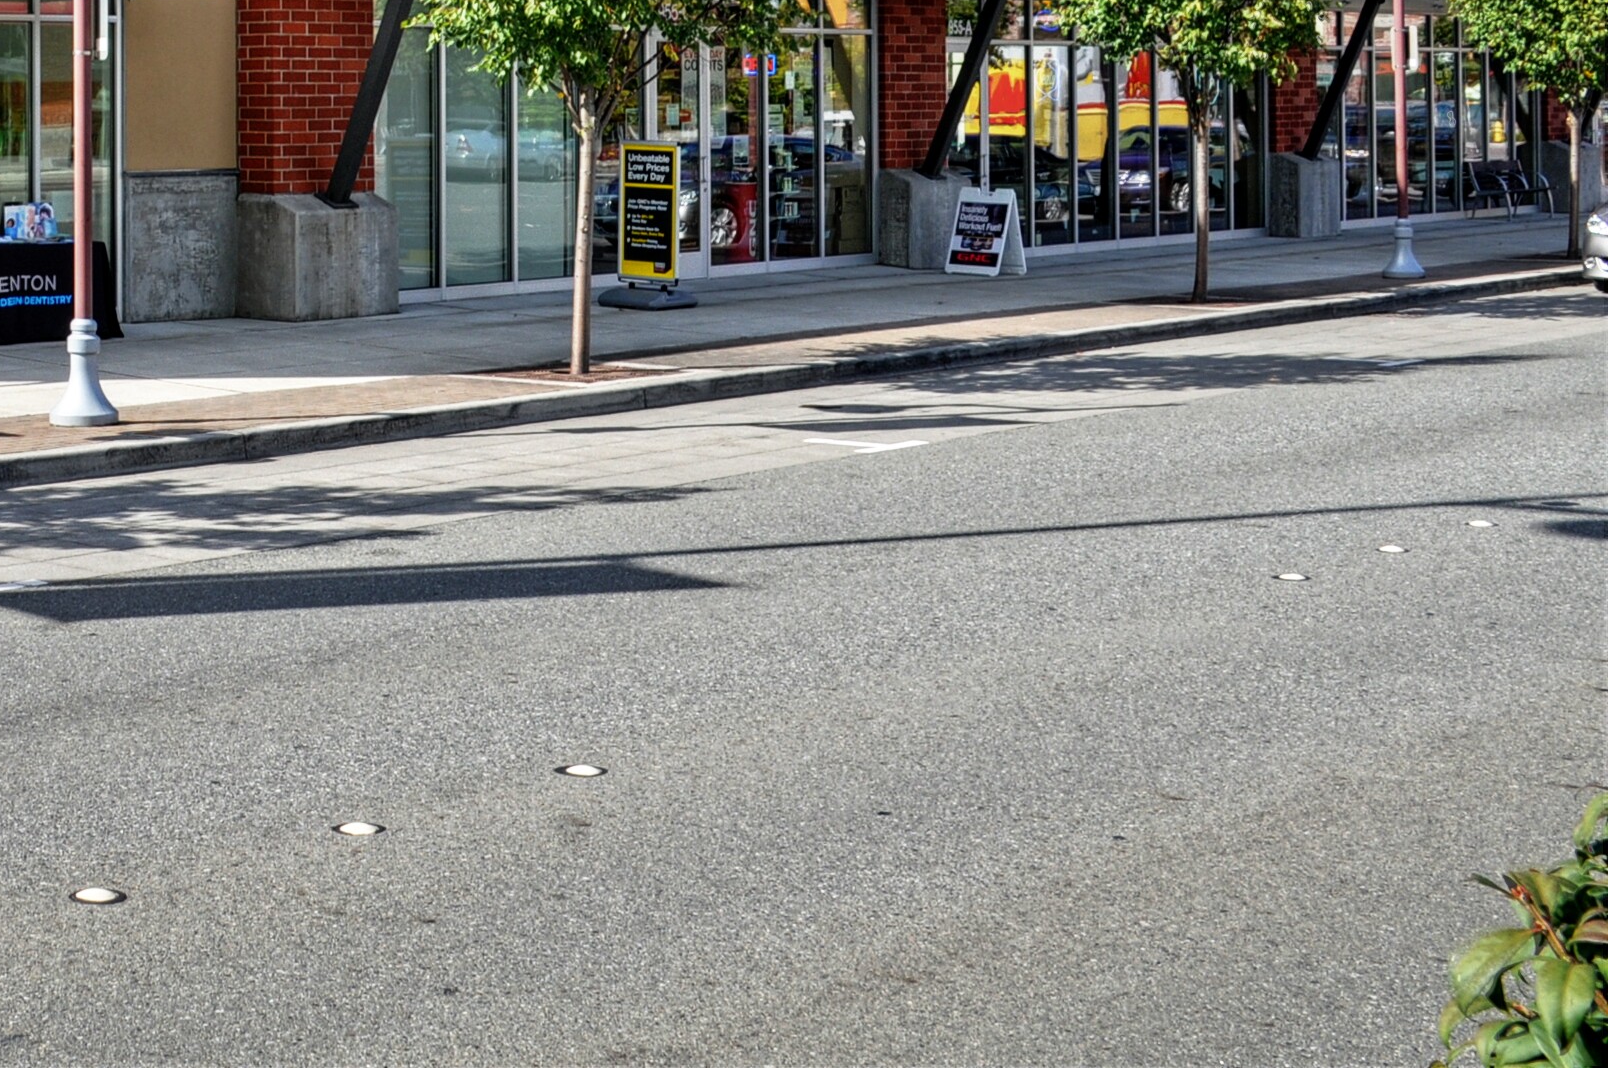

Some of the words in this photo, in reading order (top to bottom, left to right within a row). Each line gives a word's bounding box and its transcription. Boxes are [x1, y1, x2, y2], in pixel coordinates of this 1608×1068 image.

[684, 59, 724, 72] COTS
[742, 57, 773, 72] OPN
[628, 153, 670, 163] Unbeatable
[628, 162, 644, 171] Low
[646, 163, 670, 173] Prices
[628, 171, 648, 182] Every
[650, 172, 665, 183] Day
[962, 205, 988, 216] Insanely
[960, 213, 989, 223] Delicious
[958, 222, 985, 231] Workout
[957, 252, 991, 263] GNC
[24, 294, 72, 306] DENTISTRY
